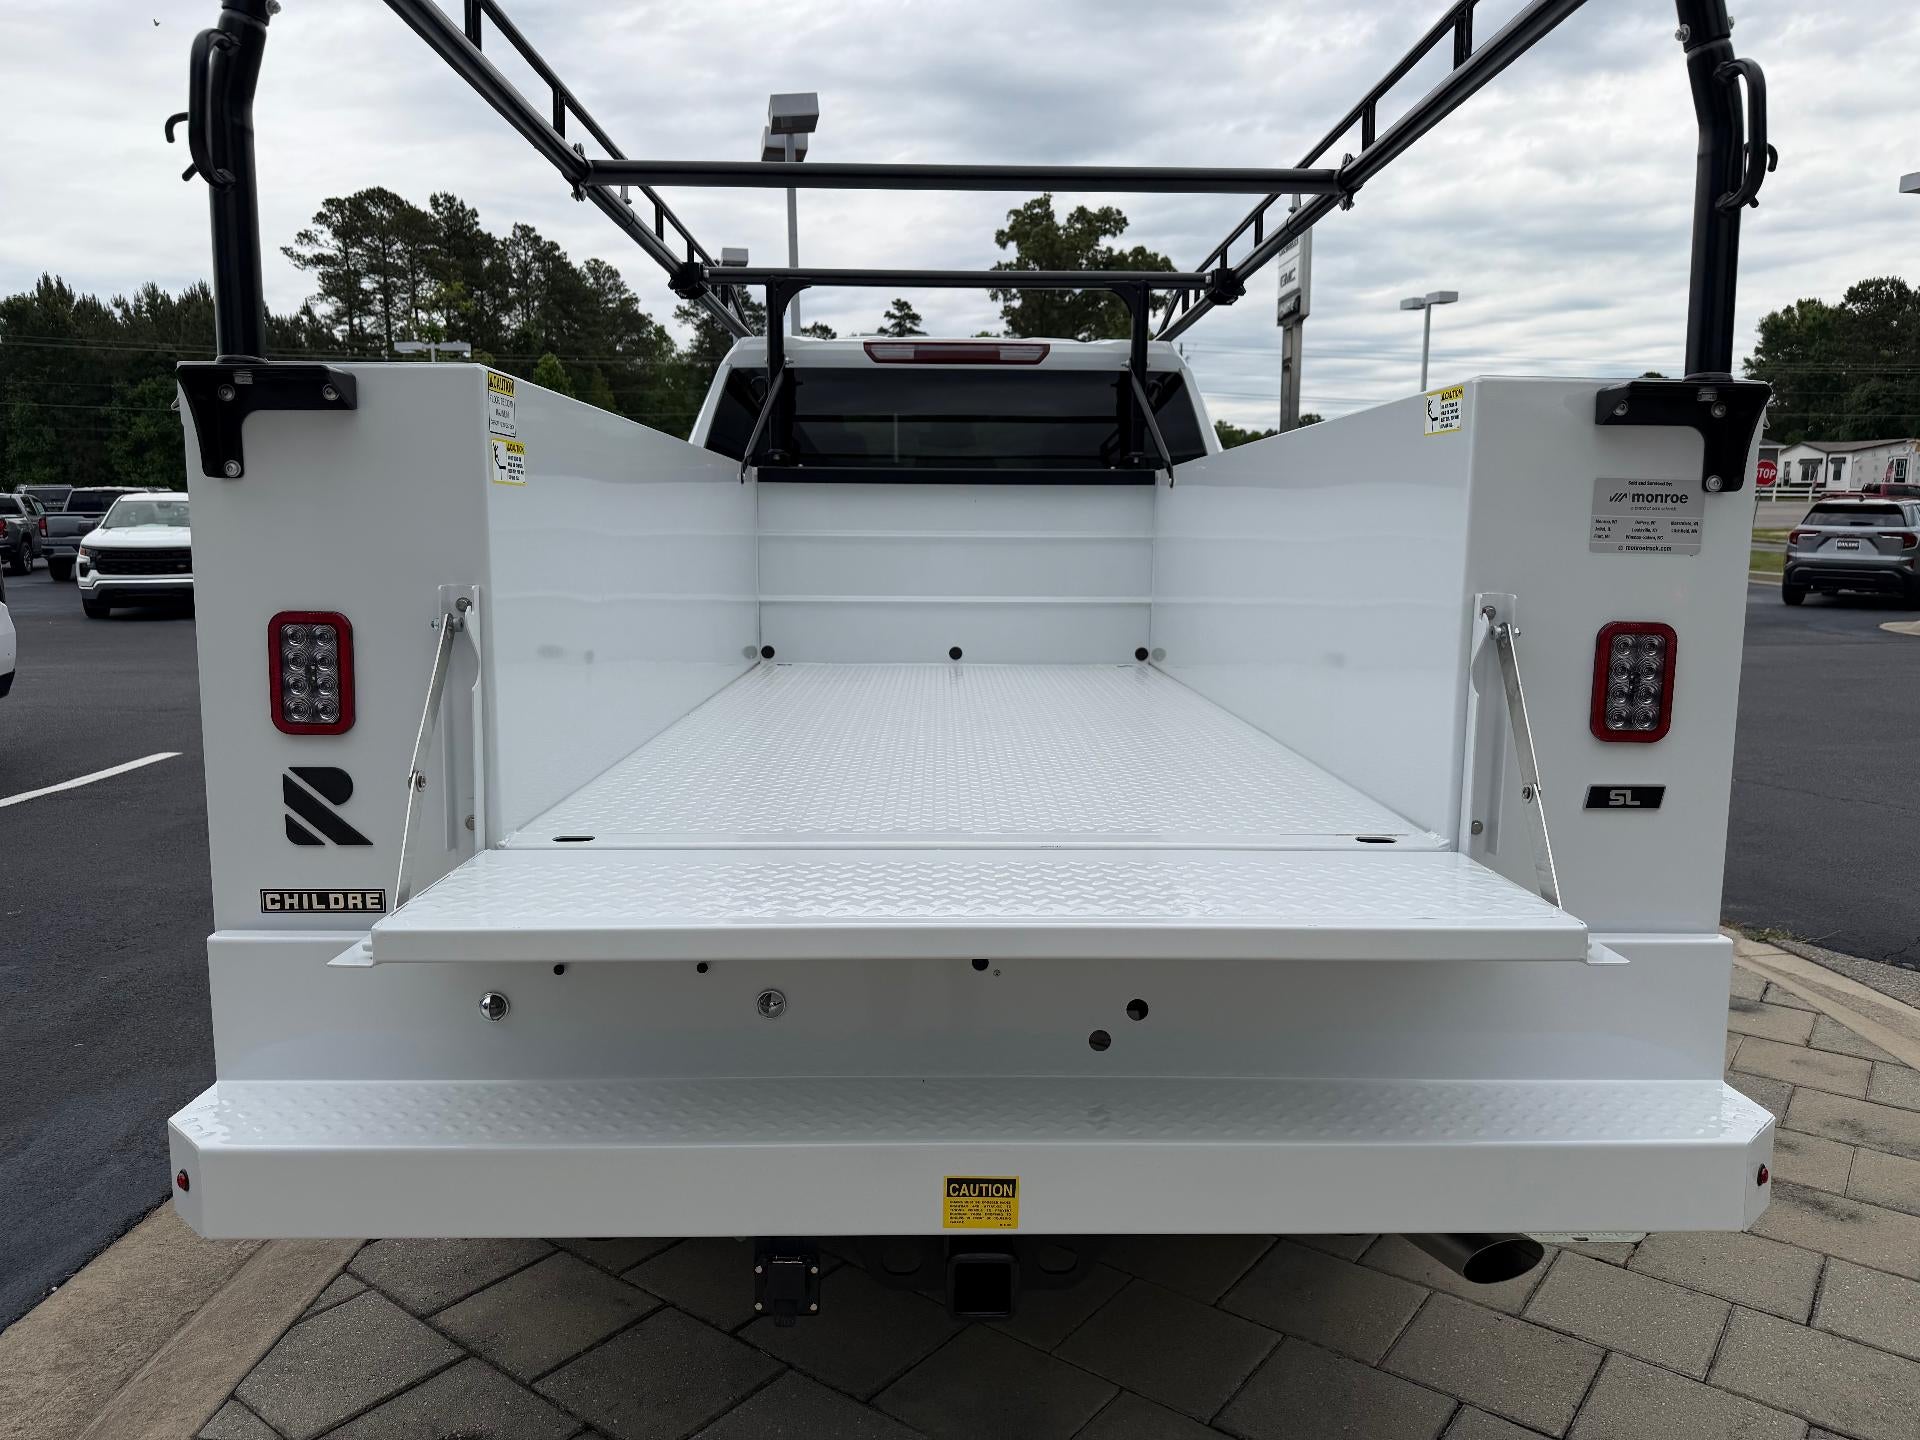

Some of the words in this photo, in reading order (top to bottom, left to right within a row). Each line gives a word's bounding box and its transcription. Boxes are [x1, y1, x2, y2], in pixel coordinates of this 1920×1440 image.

[1631, 492, 1689, 504] monroe
[1608, 789, 1641, 806] SL
[265, 893, 381, 910] CHILDRE
[949, 1183, 1013, 1197] CAUTION
